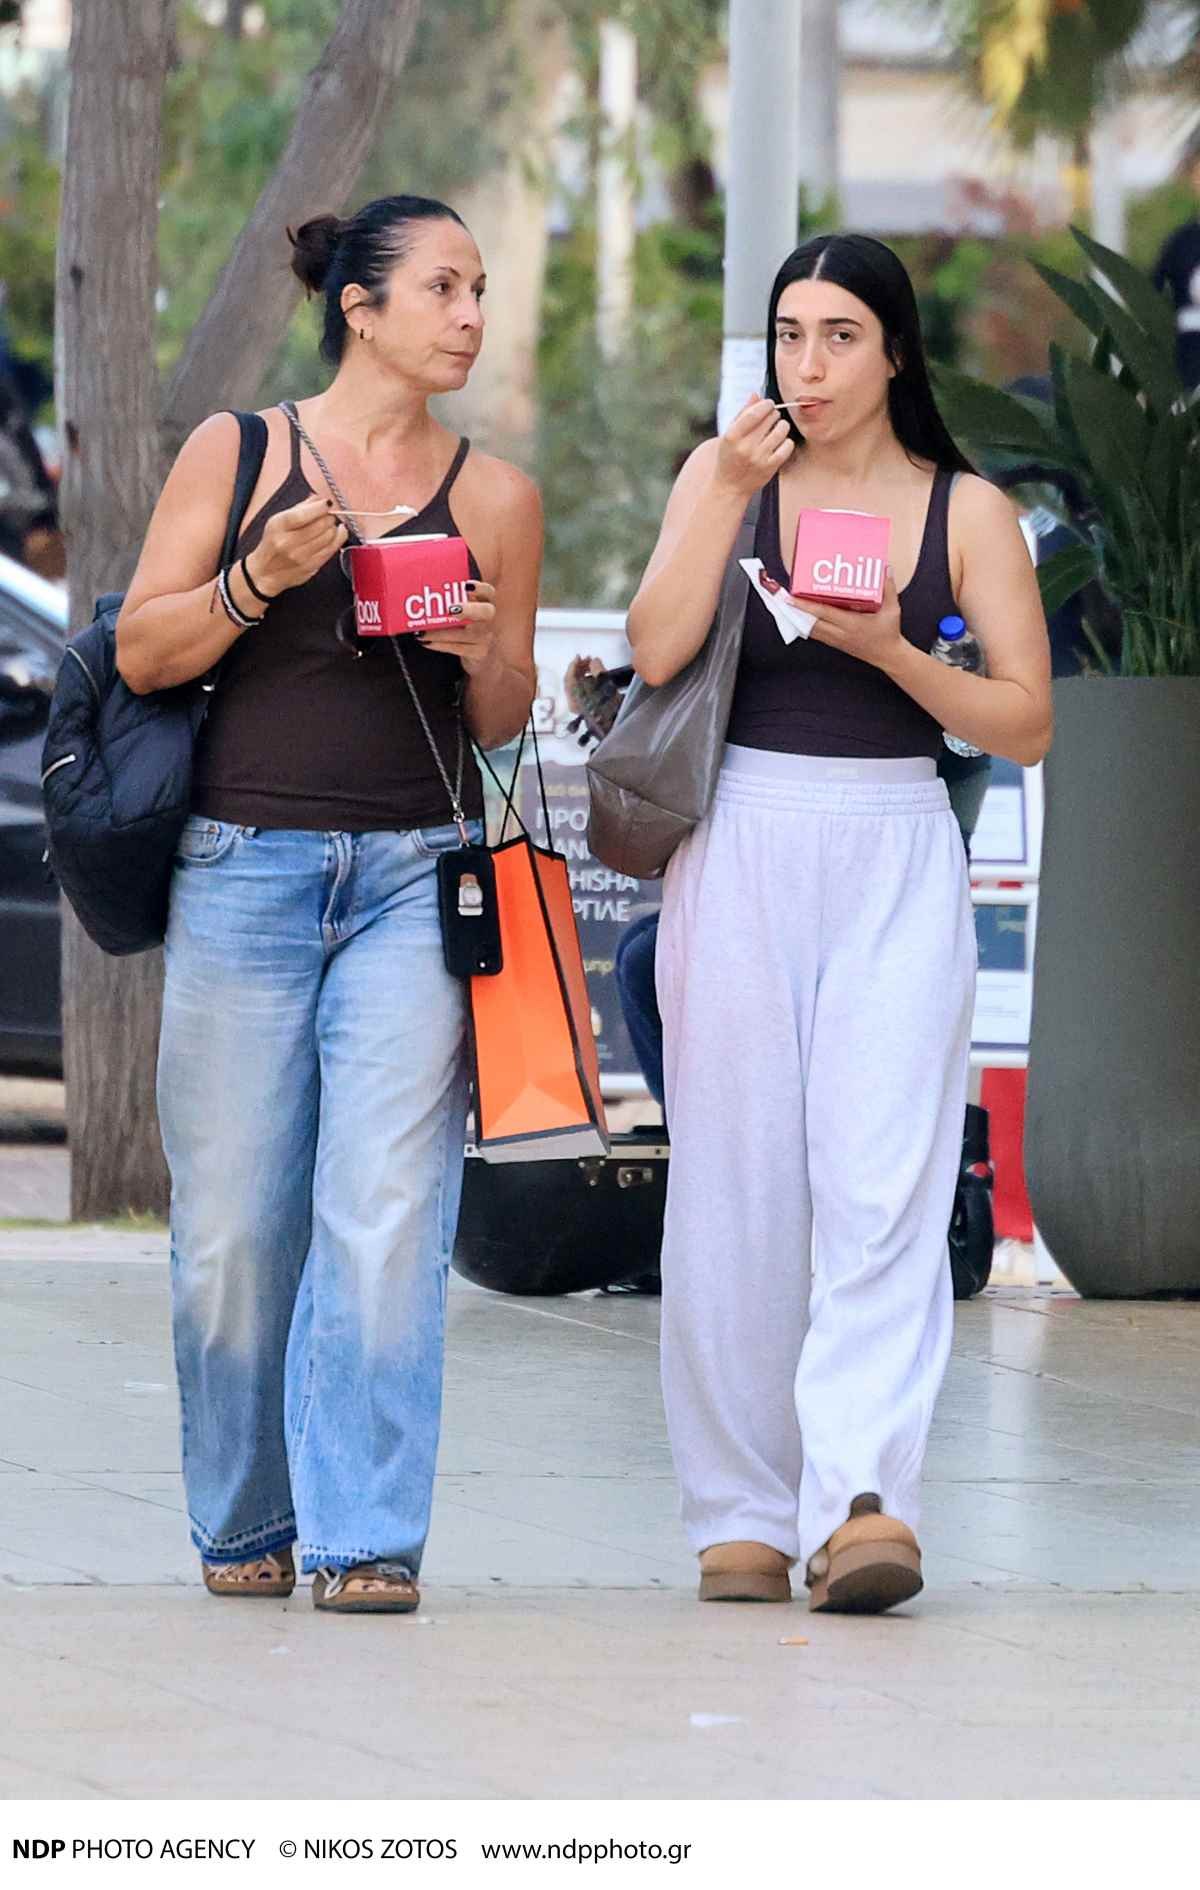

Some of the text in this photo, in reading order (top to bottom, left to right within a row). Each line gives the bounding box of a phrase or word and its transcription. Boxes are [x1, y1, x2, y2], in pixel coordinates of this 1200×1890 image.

[813, 553, 882, 590] chill
[405, 580, 468, 619] chill
[536, 809, 590, 832] ΠΡΟ
[569, 869, 640, 893] HISHA
